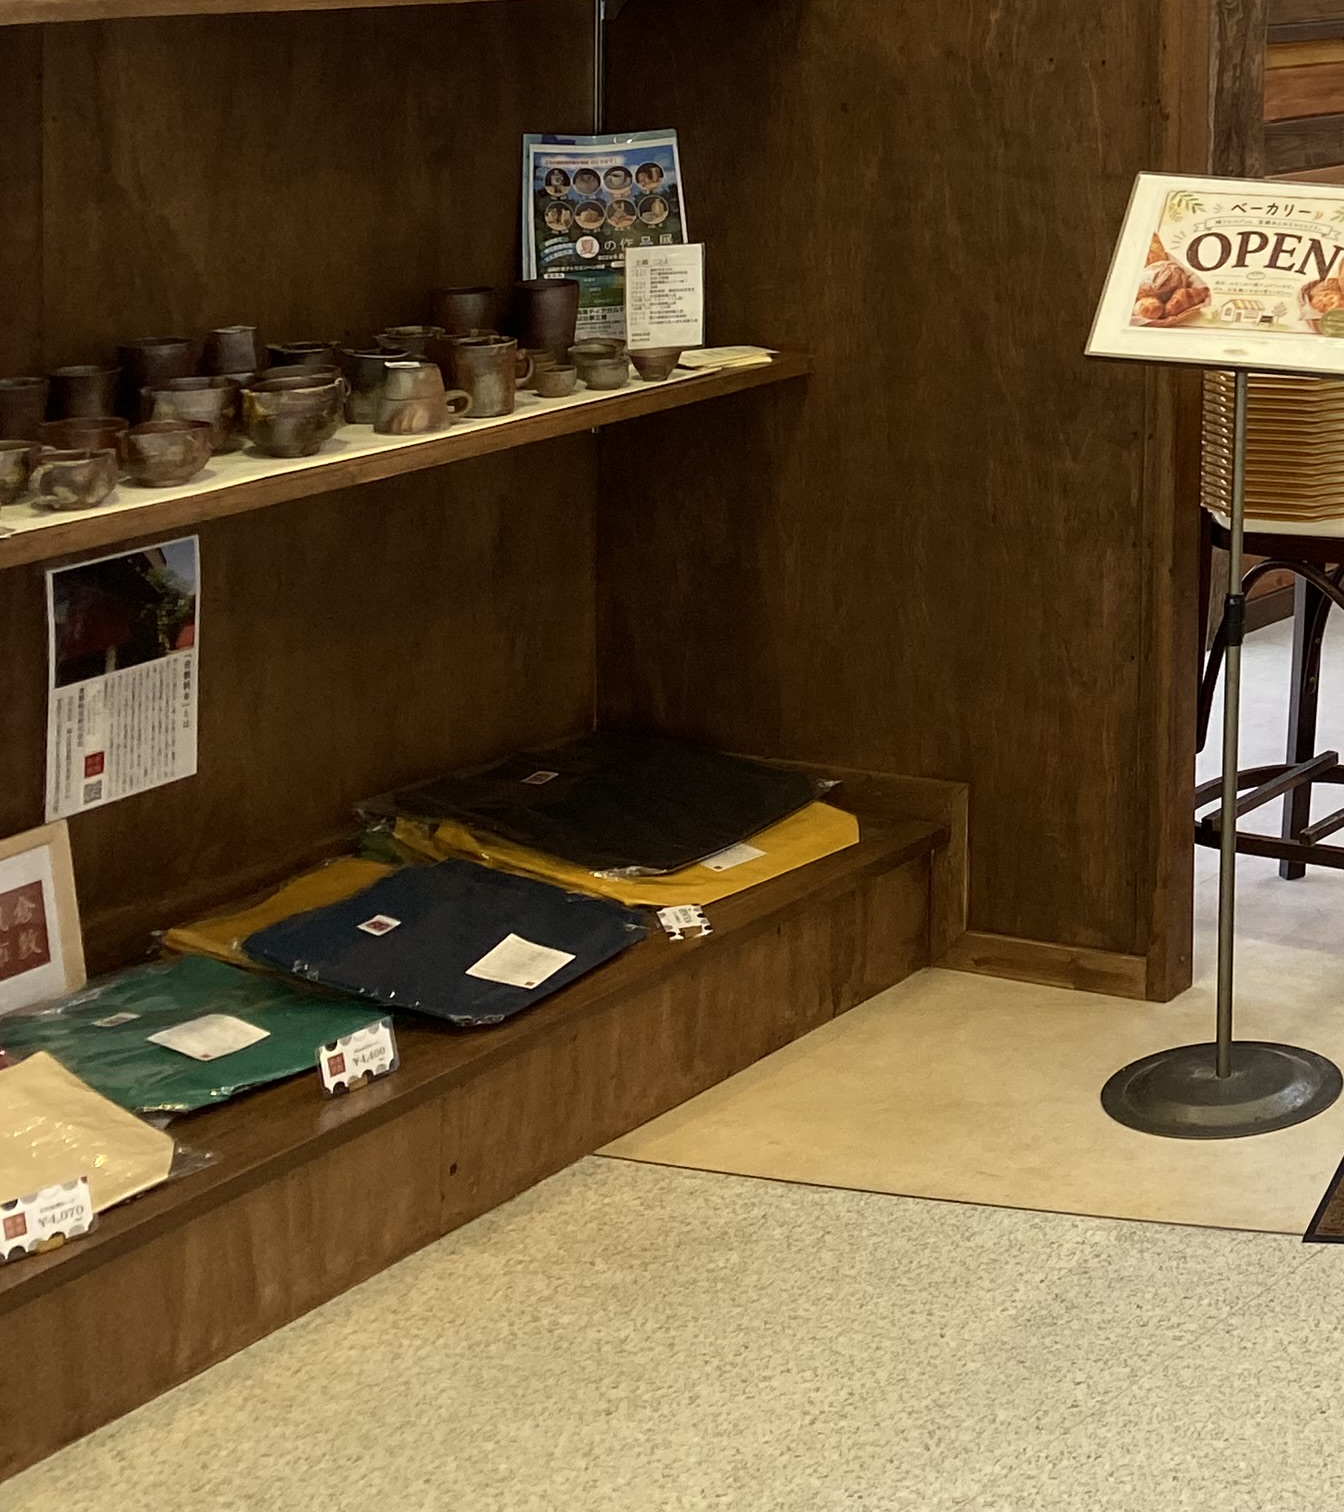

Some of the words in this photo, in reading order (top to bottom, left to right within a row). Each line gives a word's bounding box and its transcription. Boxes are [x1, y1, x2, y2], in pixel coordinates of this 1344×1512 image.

[1231, 202, 1312, 217] ベーカリー
[1186, 230, 1344, 283] OPEN
